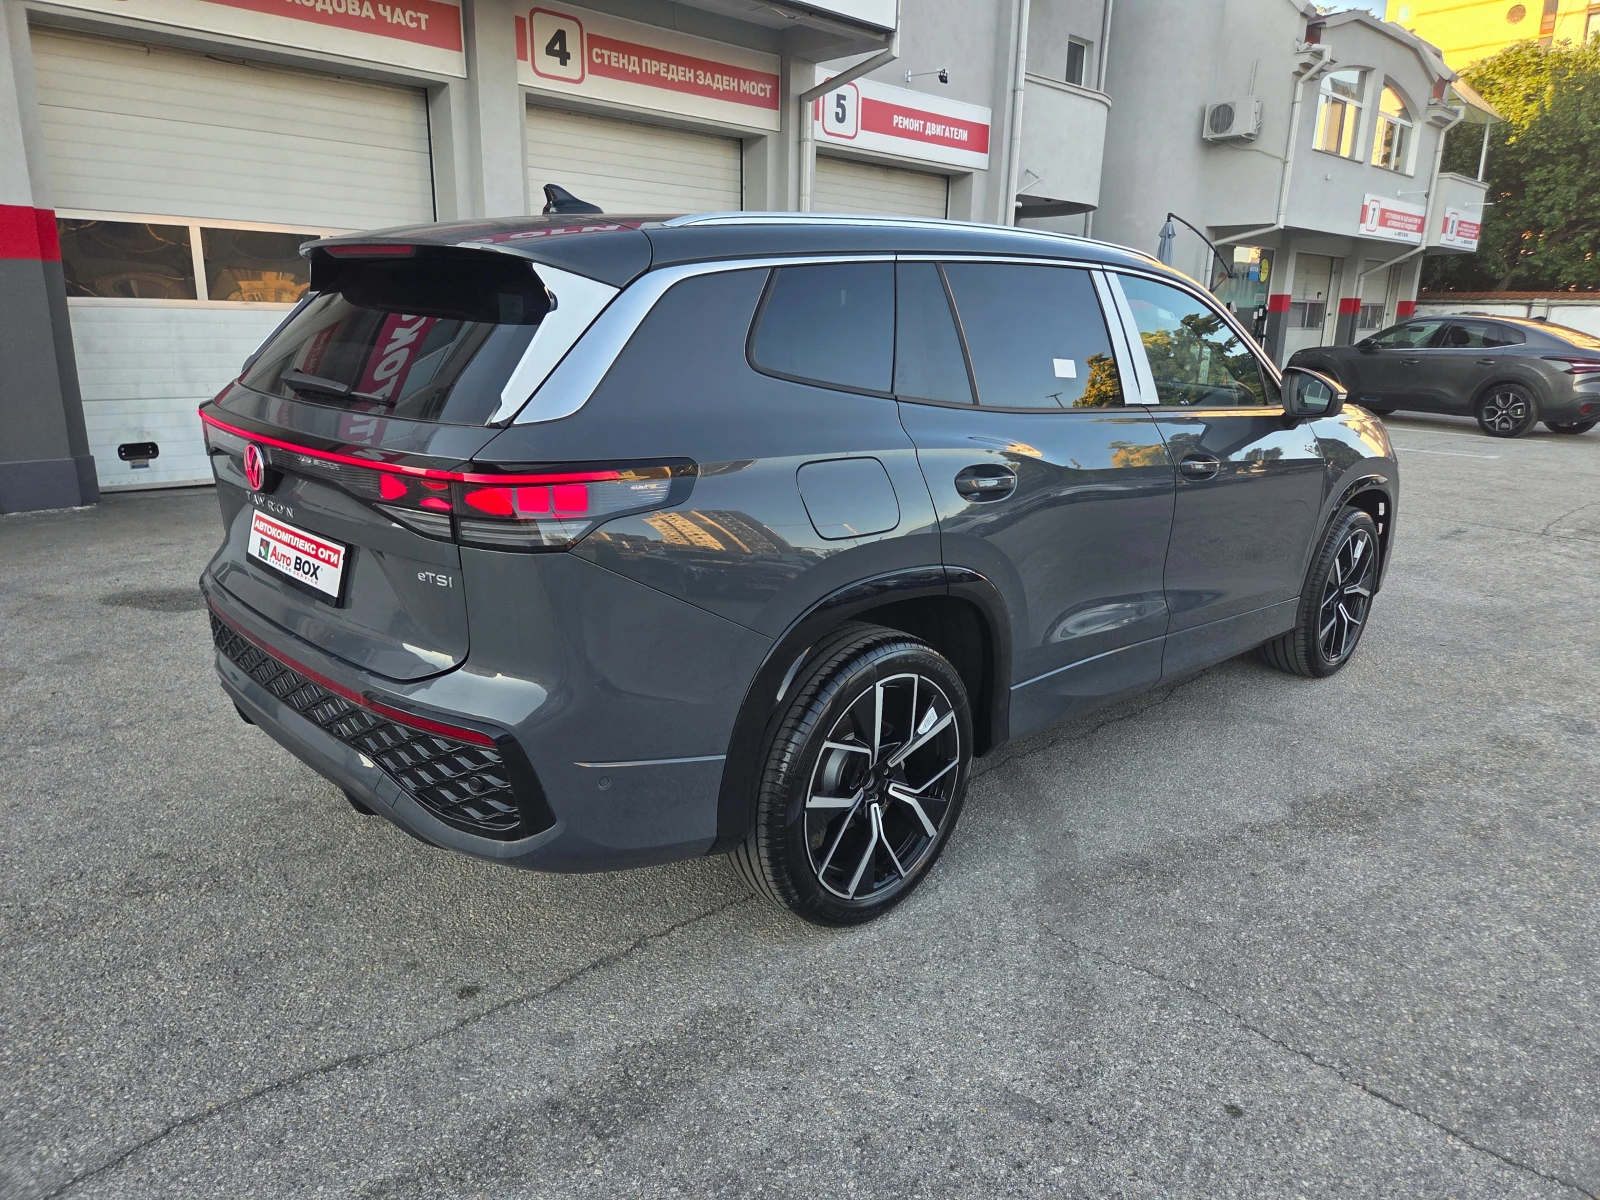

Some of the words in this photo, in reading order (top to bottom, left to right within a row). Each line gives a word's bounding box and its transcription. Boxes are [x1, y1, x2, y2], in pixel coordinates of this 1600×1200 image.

[286, 0, 376, 19] ДОВА
[378, 3, 429, 30] ЧАСТ
[545, 28, 571, 67] 4
[592, 47, 640, 75] СТЕНД
[641, 58, 695, 83] ПРЕДЕН
[696, 70, 738, 92] ЗАДЕН
[740, 79, 772, 98] МОСТ
[834, 93, 847, 124] 5
[893, 114, 925, 133] РЕМОНТ
[925, 121, 968, 142] ДВИГАТЕЛИ
[254, 519, 317, 555] АВТОКОМПЛЕКС
[318, 547, 339, 565] ОГИ
[293, 555, 321, 581] BOX
[417, 571, 453, 588] eTSI
